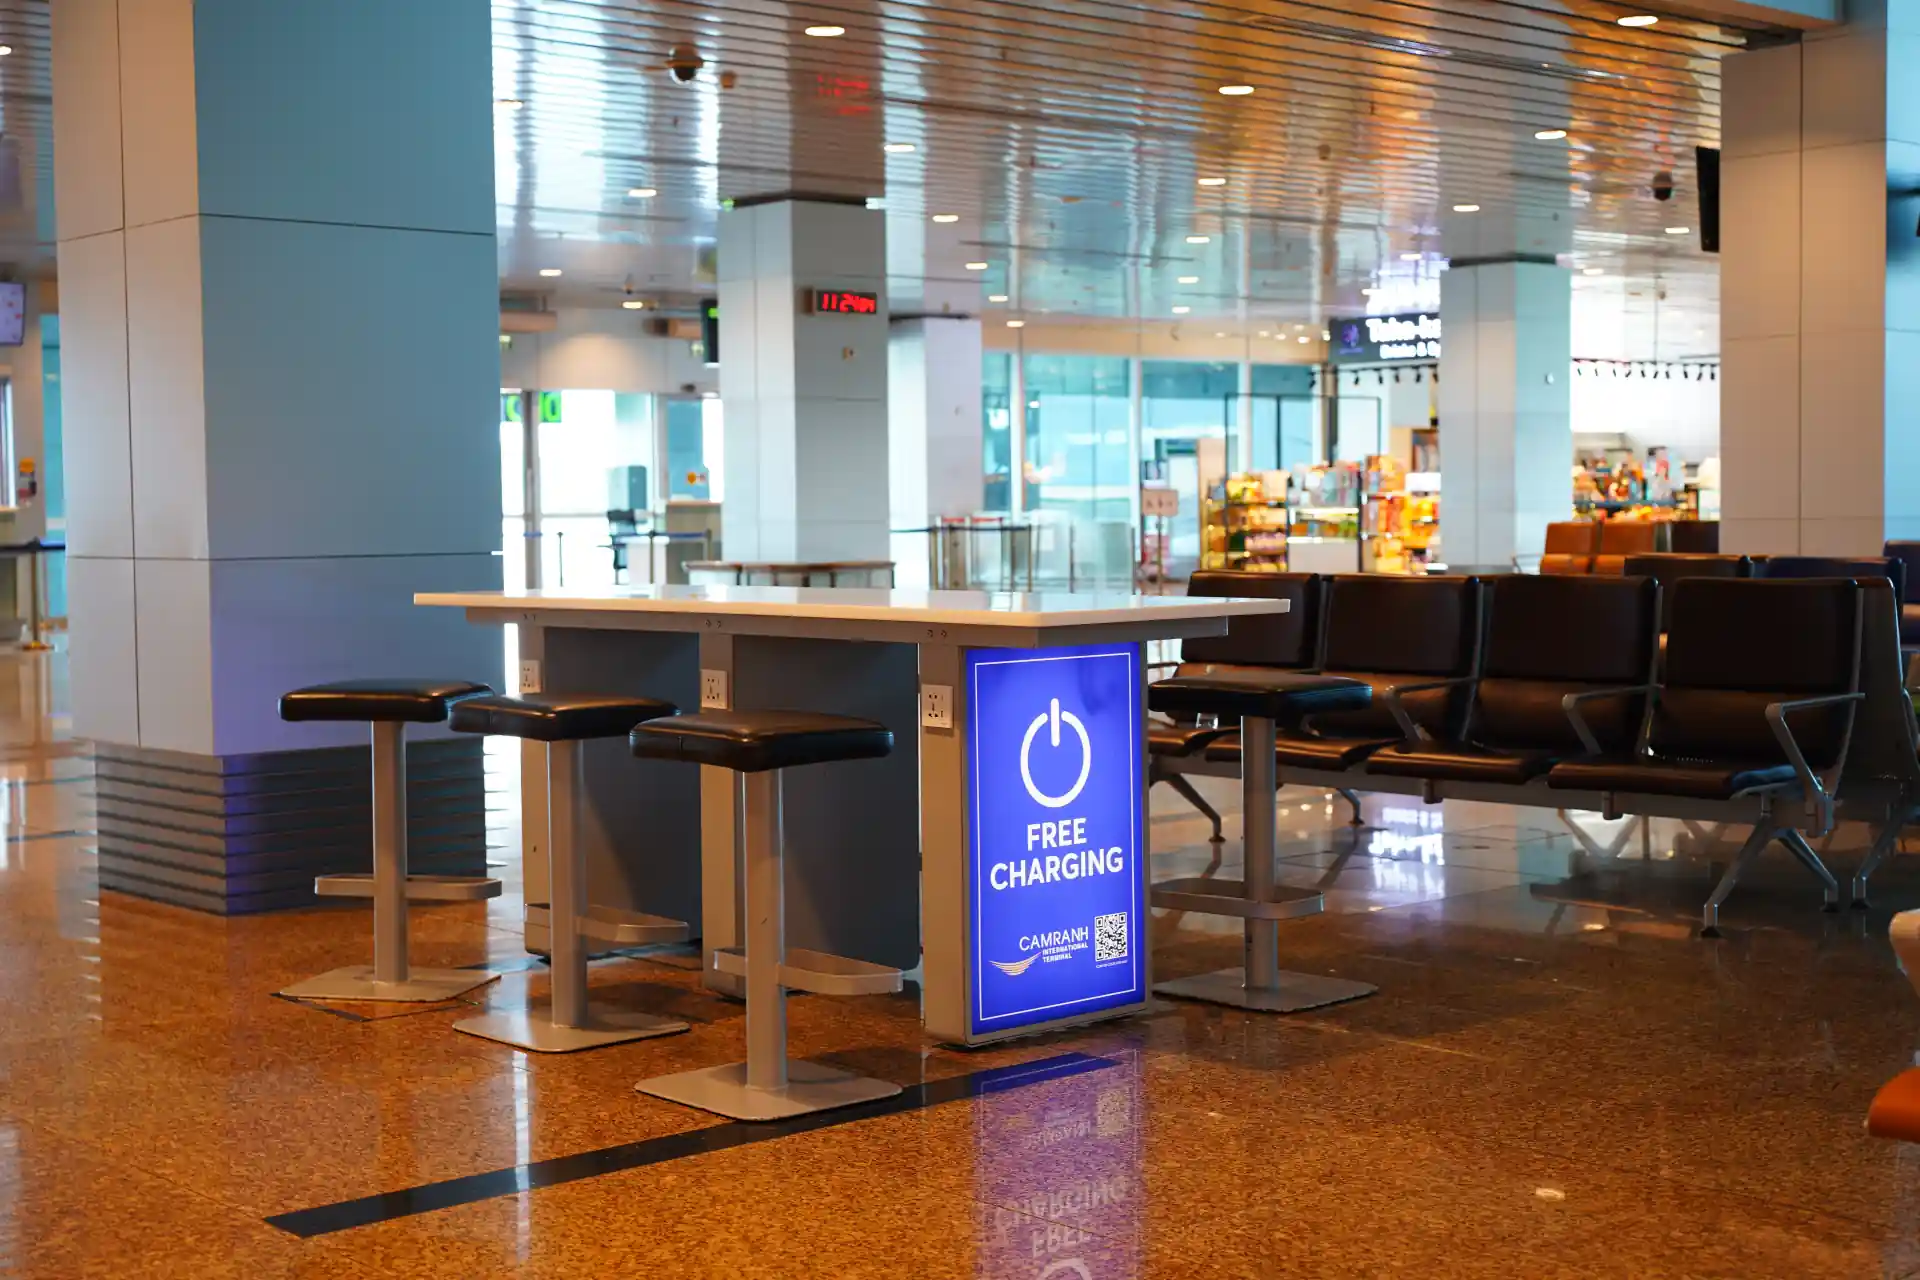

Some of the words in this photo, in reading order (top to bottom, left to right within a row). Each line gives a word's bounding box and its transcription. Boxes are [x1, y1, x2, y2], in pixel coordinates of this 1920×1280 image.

[1027, 818, 1087, 851] FREE
[990, 846, 1123, 890] CHARGING
[1019, 926, 1089, 951] CAMRANH
[1042, 942, 1088, 955] INTERNATIONAL
[1042, 953, 1072, 963] TERMINAL
